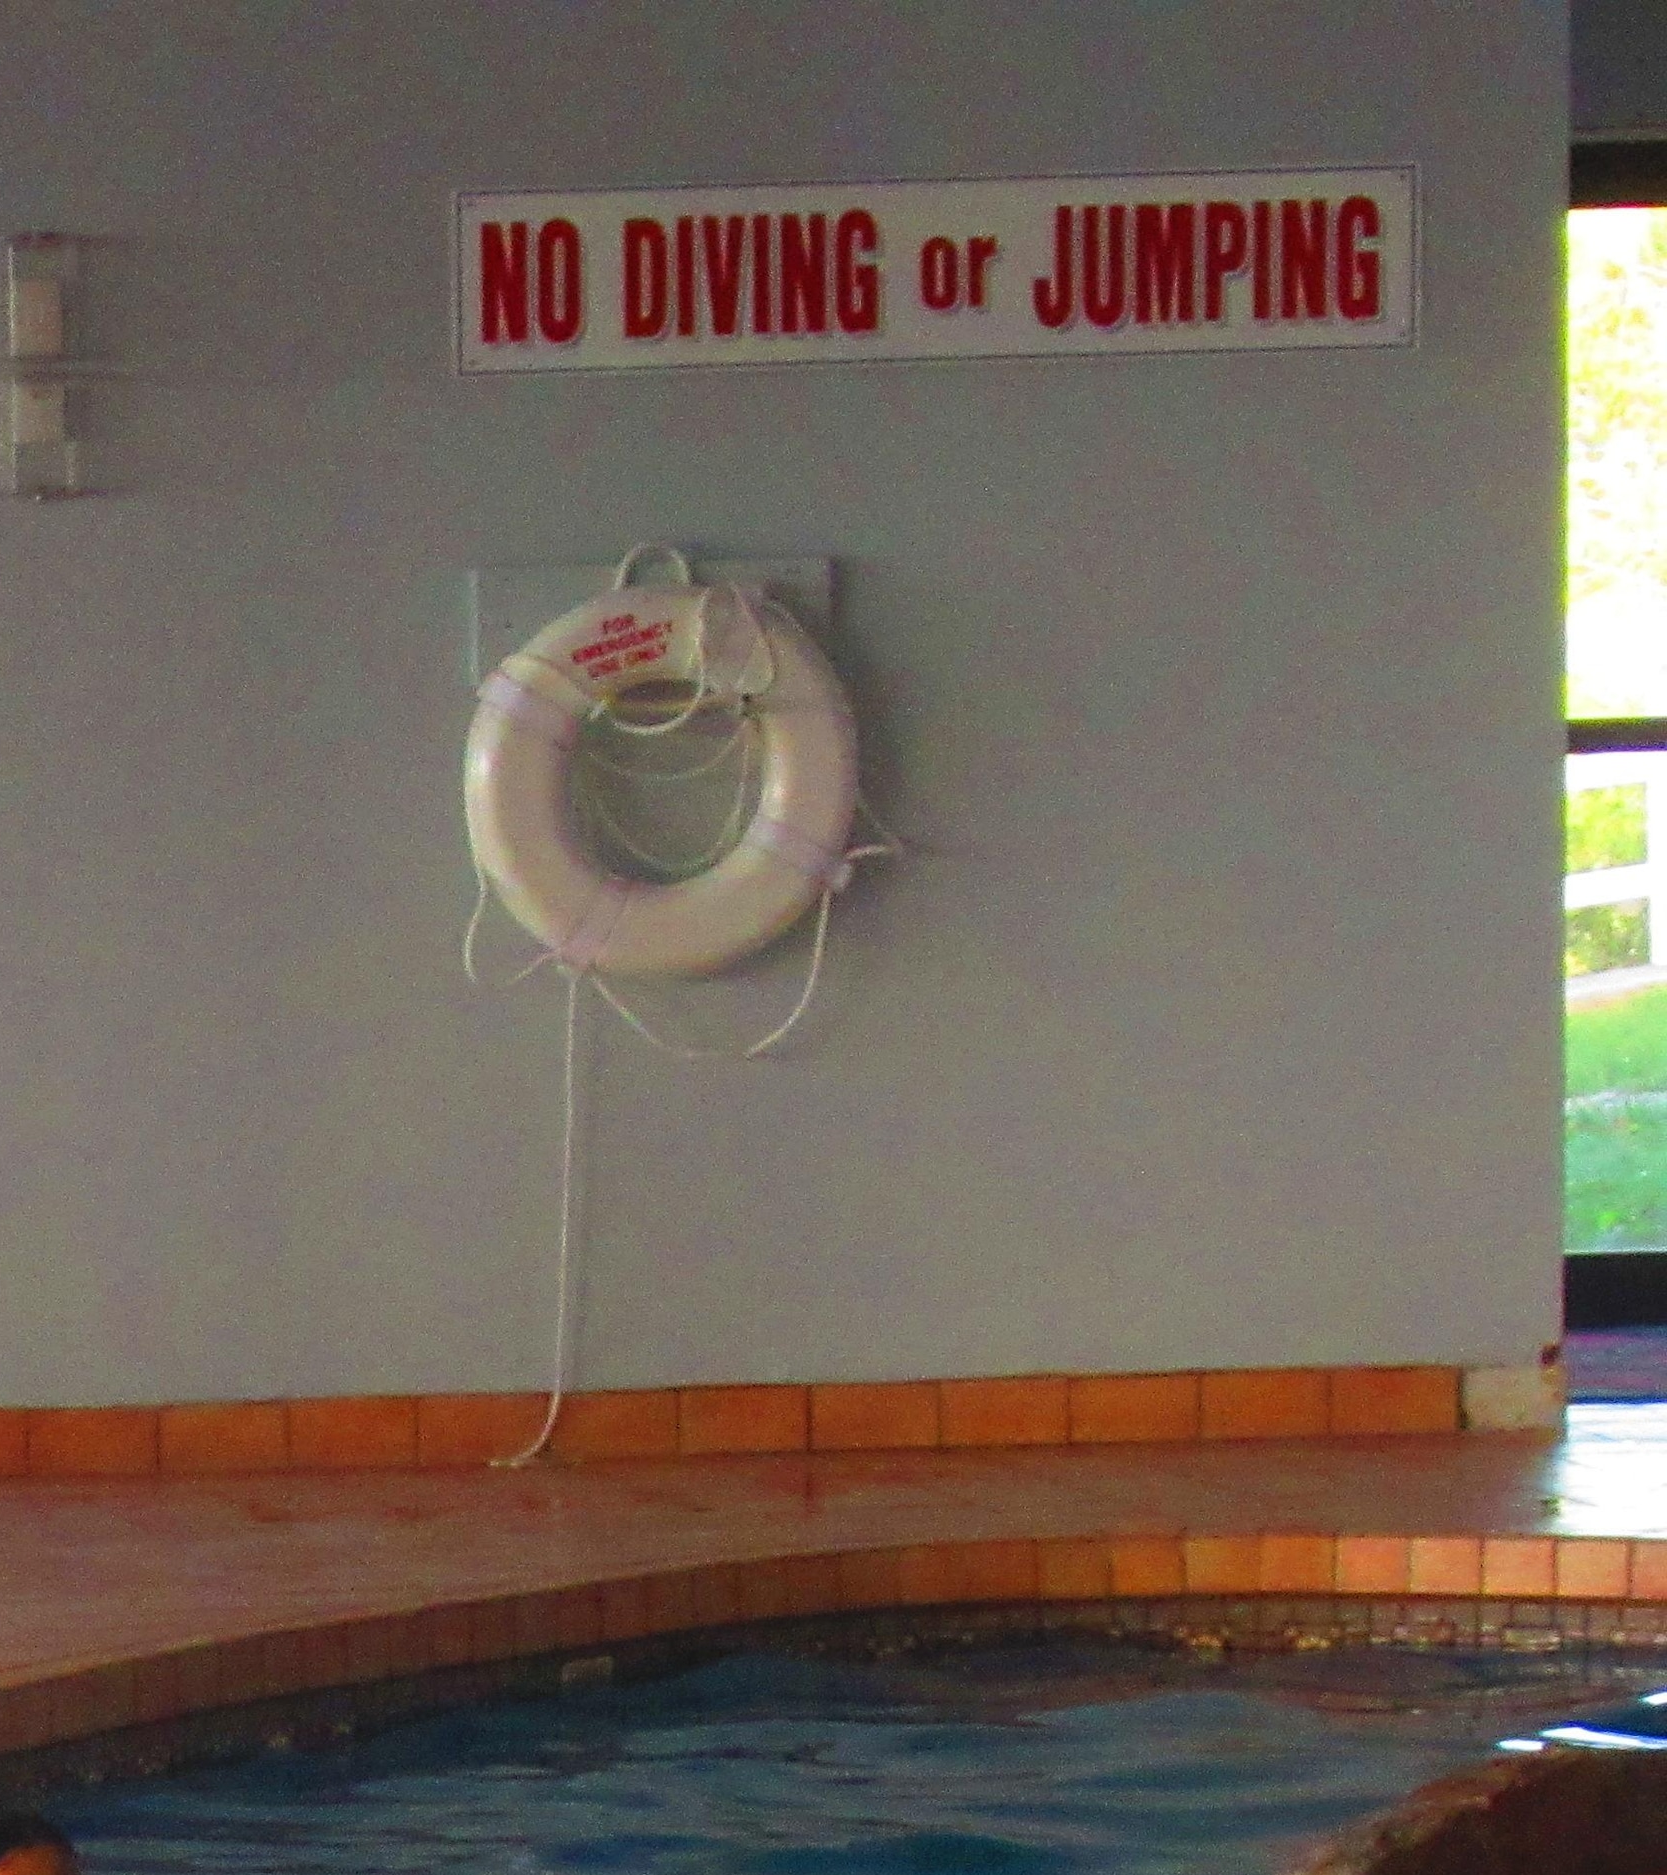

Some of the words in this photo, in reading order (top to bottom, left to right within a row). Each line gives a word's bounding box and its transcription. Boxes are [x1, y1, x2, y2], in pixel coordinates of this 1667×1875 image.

[480, 217, 583, 346] NO
[622, 208, 880, 339] DIVING
[919, 236, 998, 311] or
[1033, 195, 1381, 329] JUMPING
